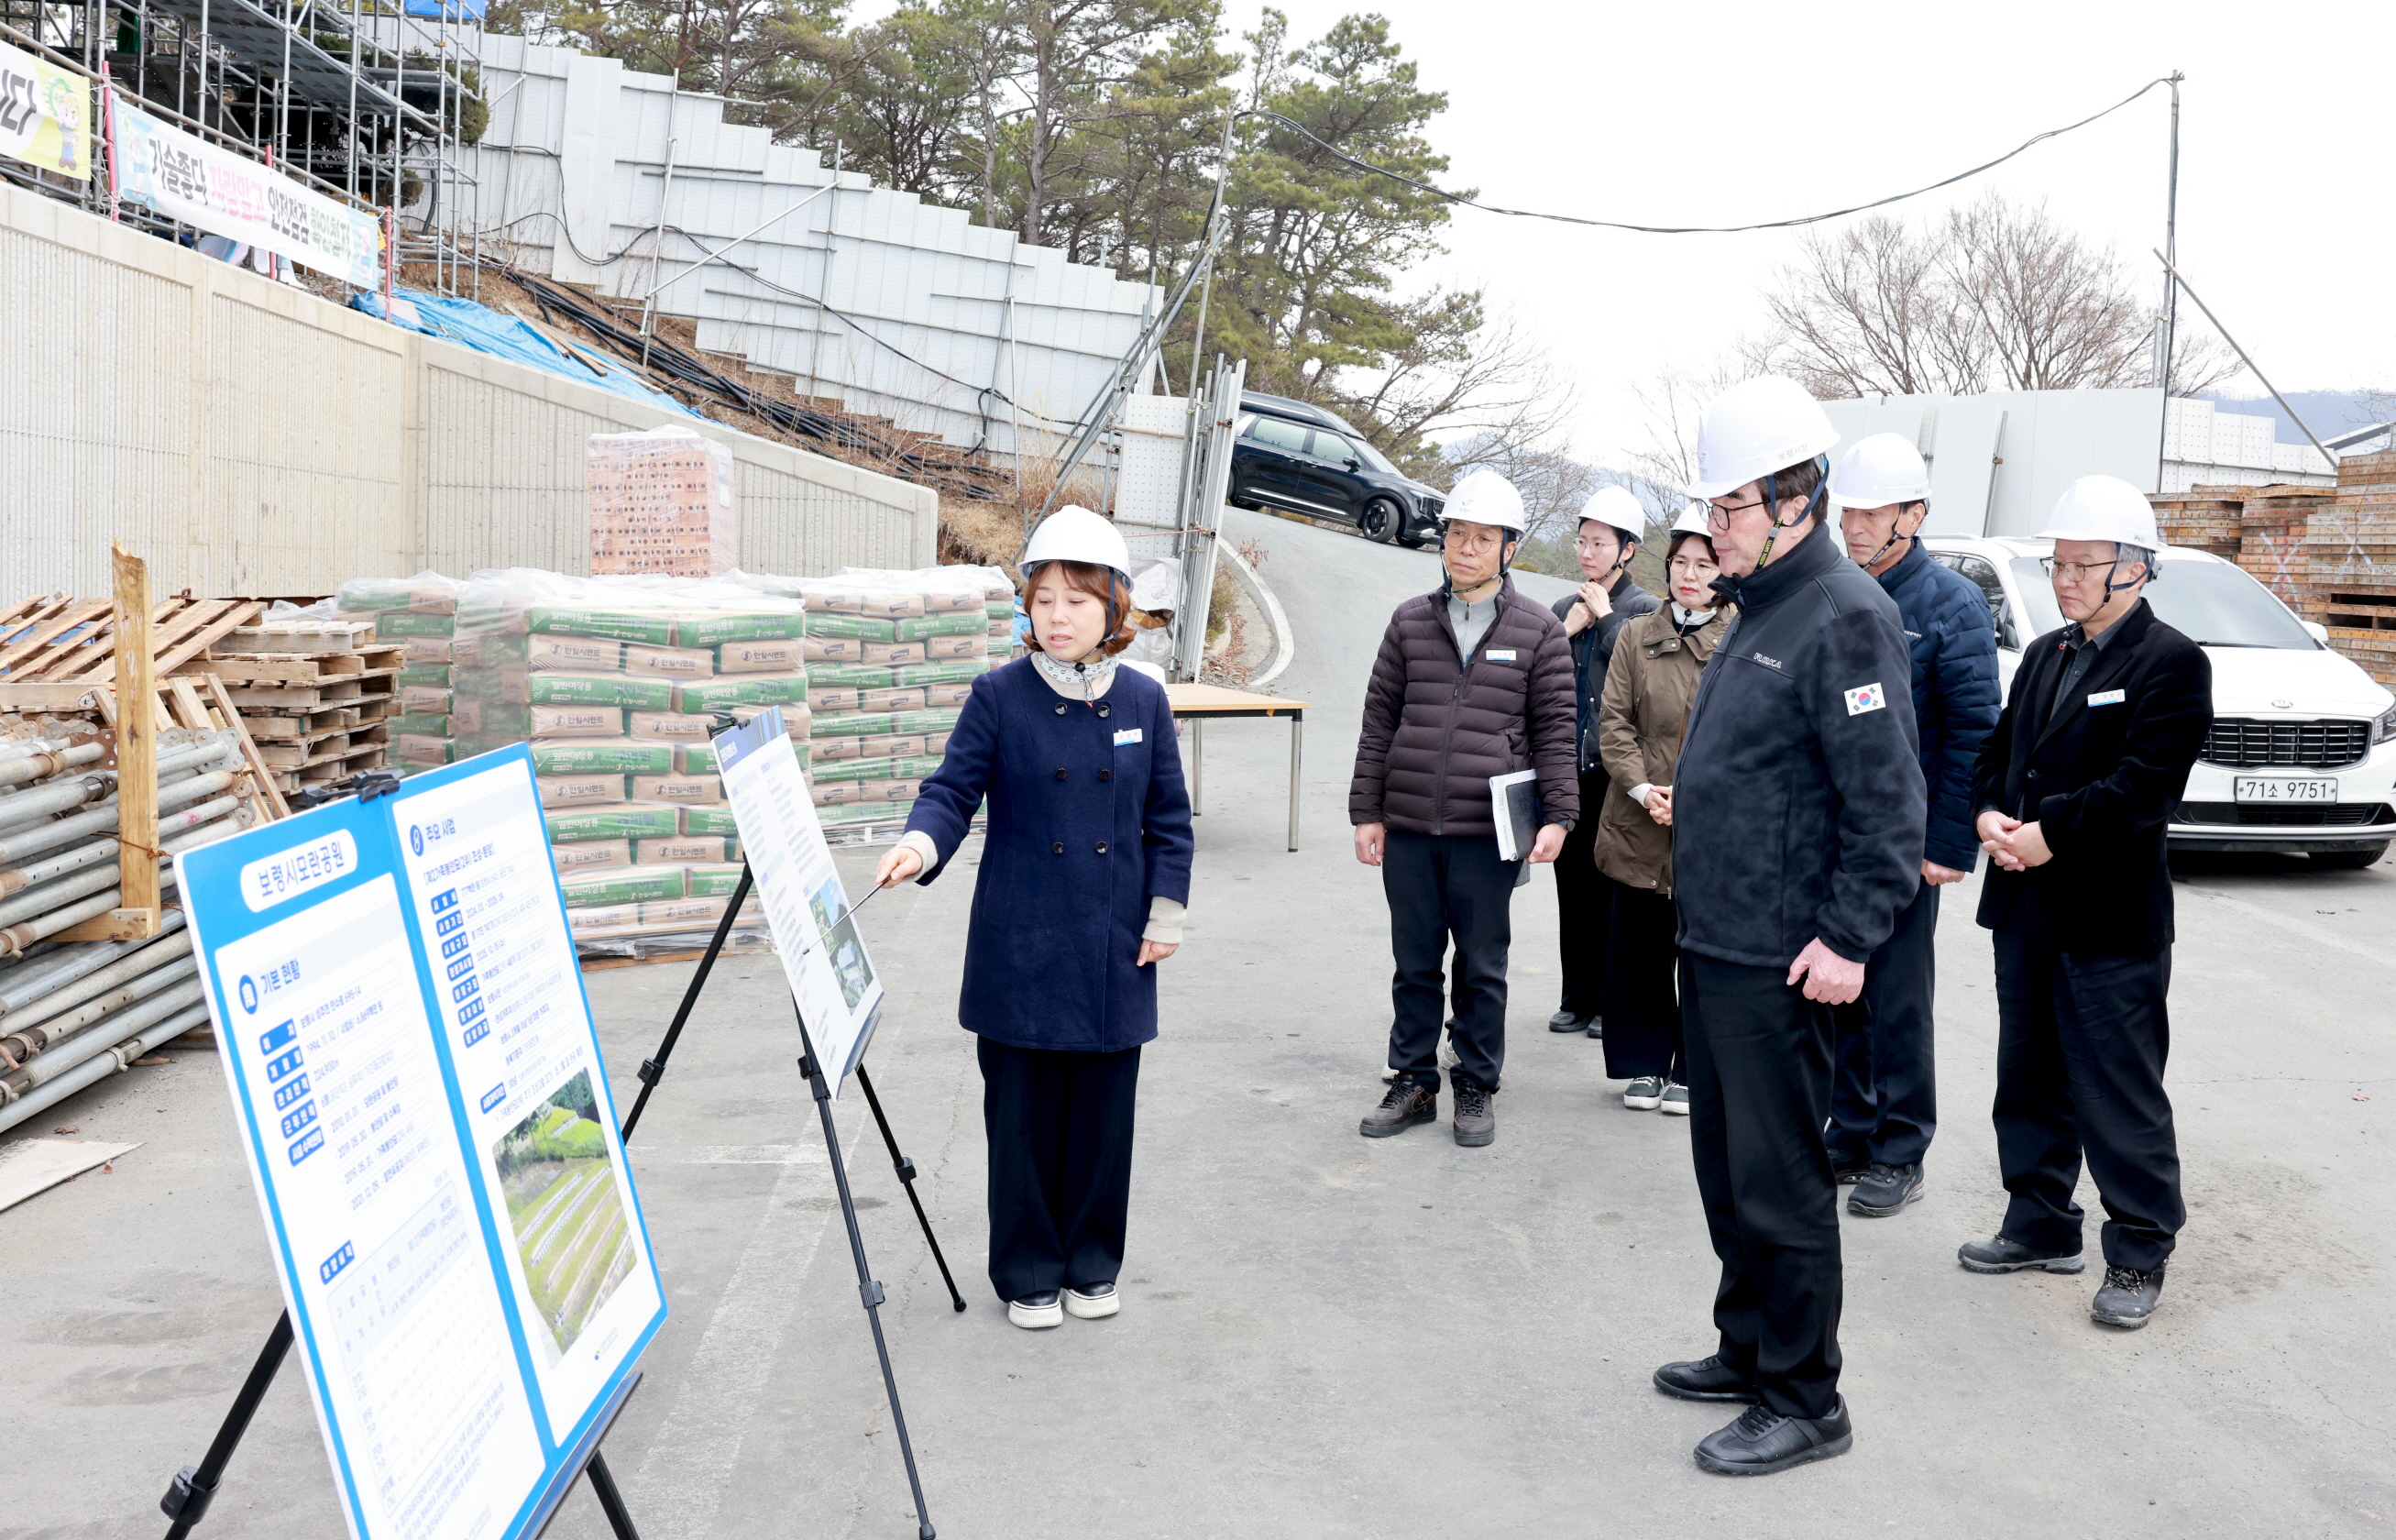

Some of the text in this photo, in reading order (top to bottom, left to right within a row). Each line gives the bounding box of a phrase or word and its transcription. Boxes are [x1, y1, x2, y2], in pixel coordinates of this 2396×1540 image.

[149, 138, 351, 262] 기술좋다 자랑말고 안전점검 확인철저
[1778, 444, 1808, 460] 보령시장
[551, 611, 591, 623] 일반미장용
[698, 621, 734, 632] 일반미장용
[621, 631, 646, 639] 한일시멘트
[565, 646, 600, 656] 한일시멘트
[753, 650, 786, 658] 한일시멘트
[661, 659, 696, 667] 한일시멘트
[552, 681, 592, 691] 일반미장용
[702, 687, 738, 699] 일반미장용
[665, 722, 700, 731] 한일시멘트
[553, 751, 594, 761] 일반미장용
[569, 784, 605, 795] 한일시멘트
[668, 785, 702, 794] 한일시멘트
[2247, 782, 2325, 798] 71소 9751
[557, 818, 599, 830] 일반미장용
[424, 818, 456, 843] 주요 사업
[576, 850, 611, 861] 한일시멘트
[258, 841, 345, 896] 보령시모란공원
[566, 885, 607, 896] 일반미장용
[677, 906, 711, 915] 한일시멘트
[586, 913, 620, 923] 한일시멘트
[260, 959, 301, 995] 기본 현황
